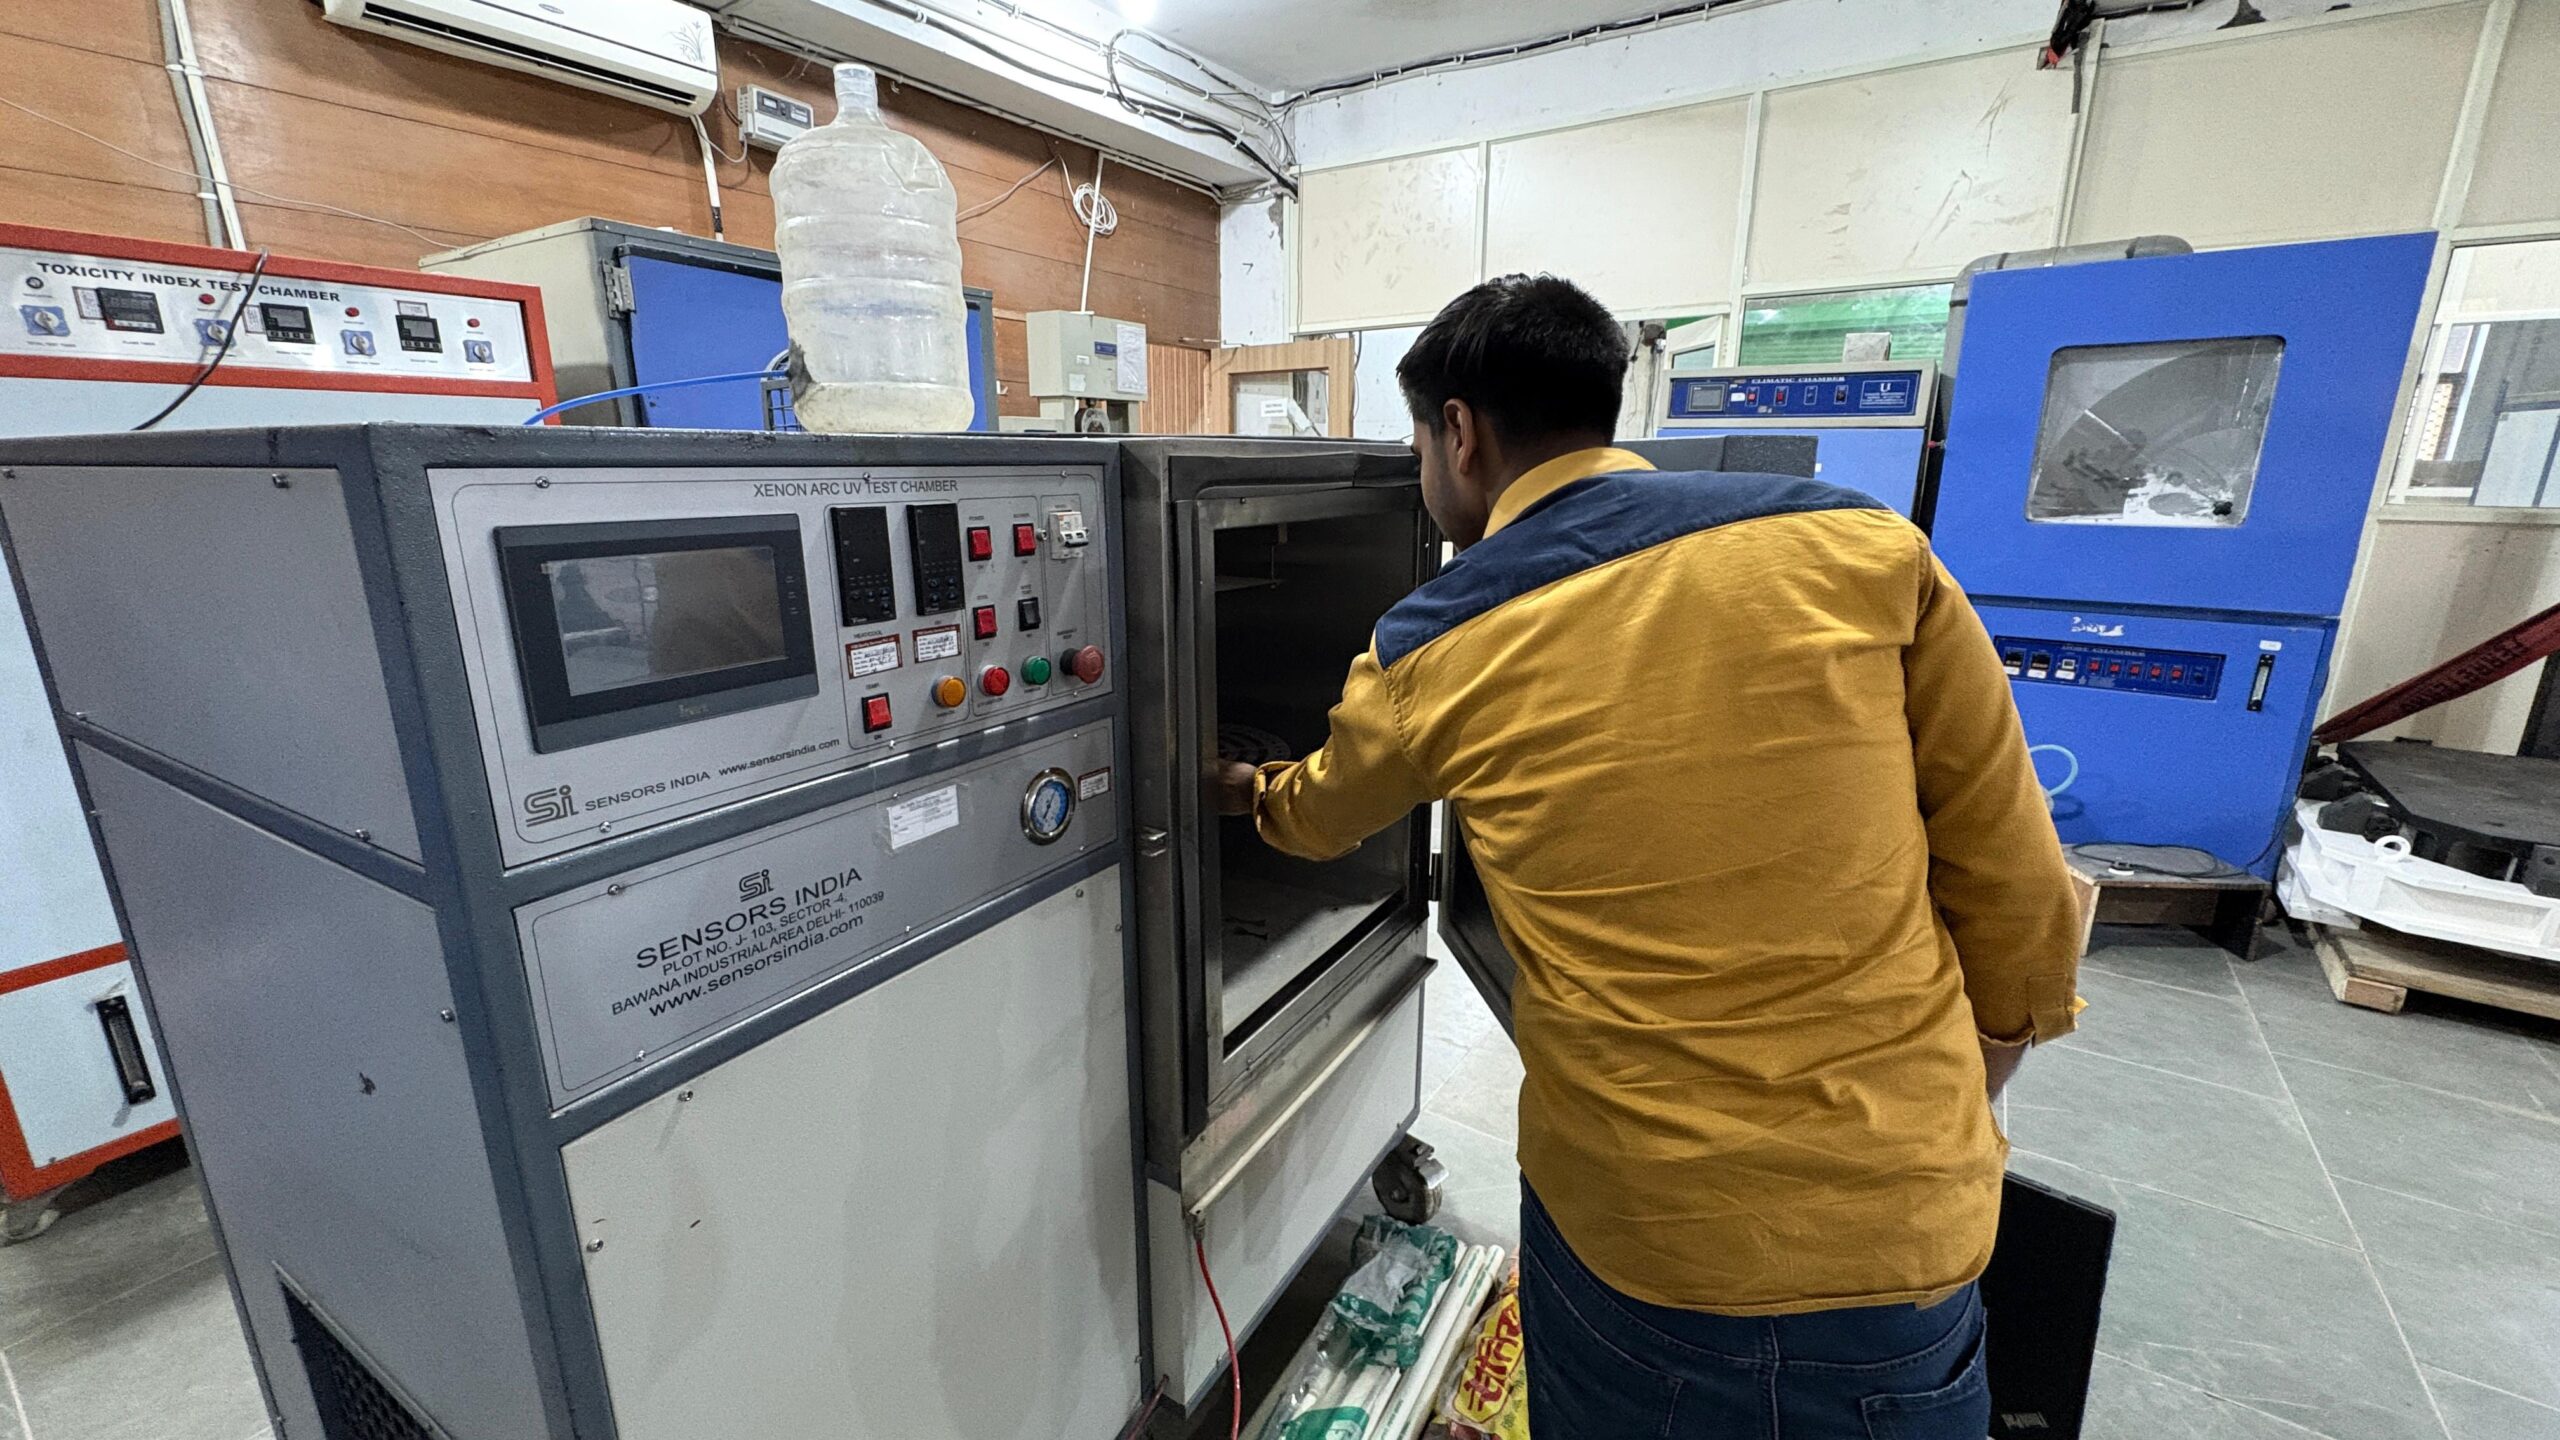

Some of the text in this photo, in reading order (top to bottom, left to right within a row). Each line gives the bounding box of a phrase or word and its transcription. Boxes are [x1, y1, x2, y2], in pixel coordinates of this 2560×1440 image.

[37, 262, 341, 302] TOXICITY INDEX TEST CHAMBER
[753, 480, 959, 498] XENON ARC UV TEST CHAMBER
[585, 782, 666, 811] SENSORS
[670, 771, 711, 789] INDIA
[718, 738, 840, 776] www.sensorsindia.com
[612, 891, 884, 1015] BAWANA INDUSTRIAL AREA DELHI- 110039
[636, 868, 862, 968] SENSORS INDIA
[663, 950, 703, 976] PLOT
[706, 941, 732, 958] NO.
[735, 935, 748, 946] J-
[780, 898, 831, 927] SECTOR
[649, 916, 863, 1017] www.sensorsindia.com
